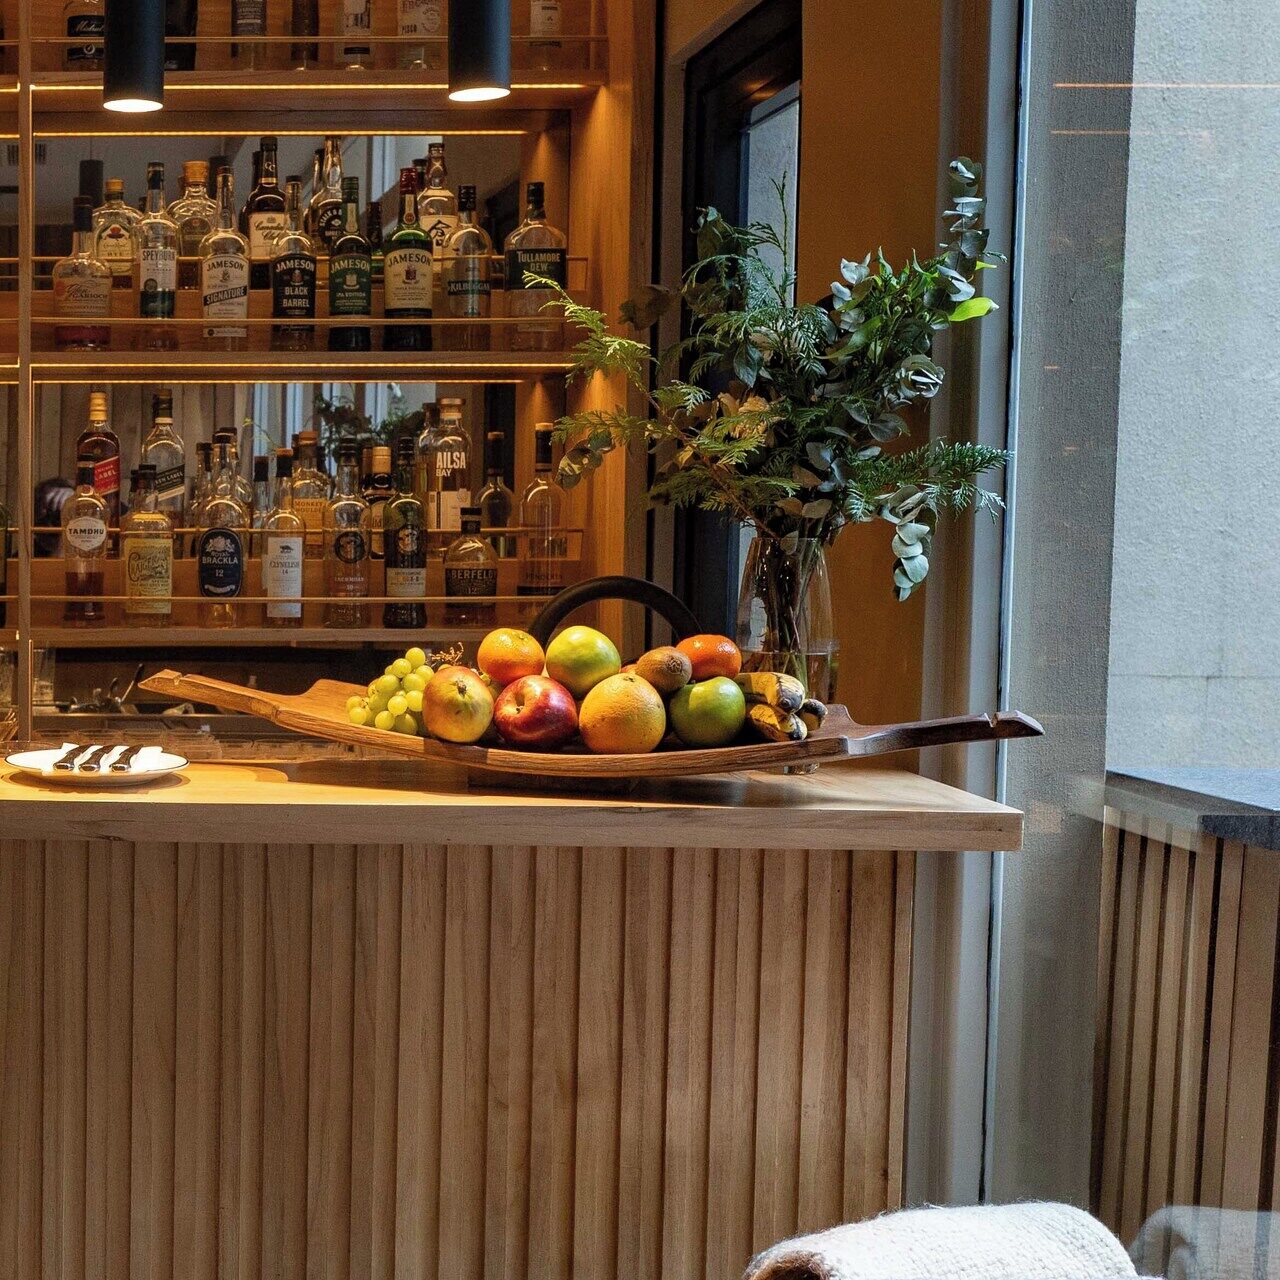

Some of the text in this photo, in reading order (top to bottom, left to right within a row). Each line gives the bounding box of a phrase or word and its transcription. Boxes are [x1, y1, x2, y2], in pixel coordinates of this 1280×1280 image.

[387, 252, 432, 267] JAMESON
[517, 252, 561, 263] TULLAMORE
[206, 260, 244, 272] JAMESON
[276, 260, 315, 272] JAMESON
[331, 260, 370, 274] JAMESON
[530, 263, 549, 272] DEW
[205, 287, 246, 304] SIGNATURE
[284, 286, 308, 296] BLACK
[283, 298, 310, 308] BARREL
[436, 451, 466, 469] AILSA
[436, 468, 452, 477] BAY
[202, 557, 239, 565] BRACKLA
[215, 569, 224, 577] 12
